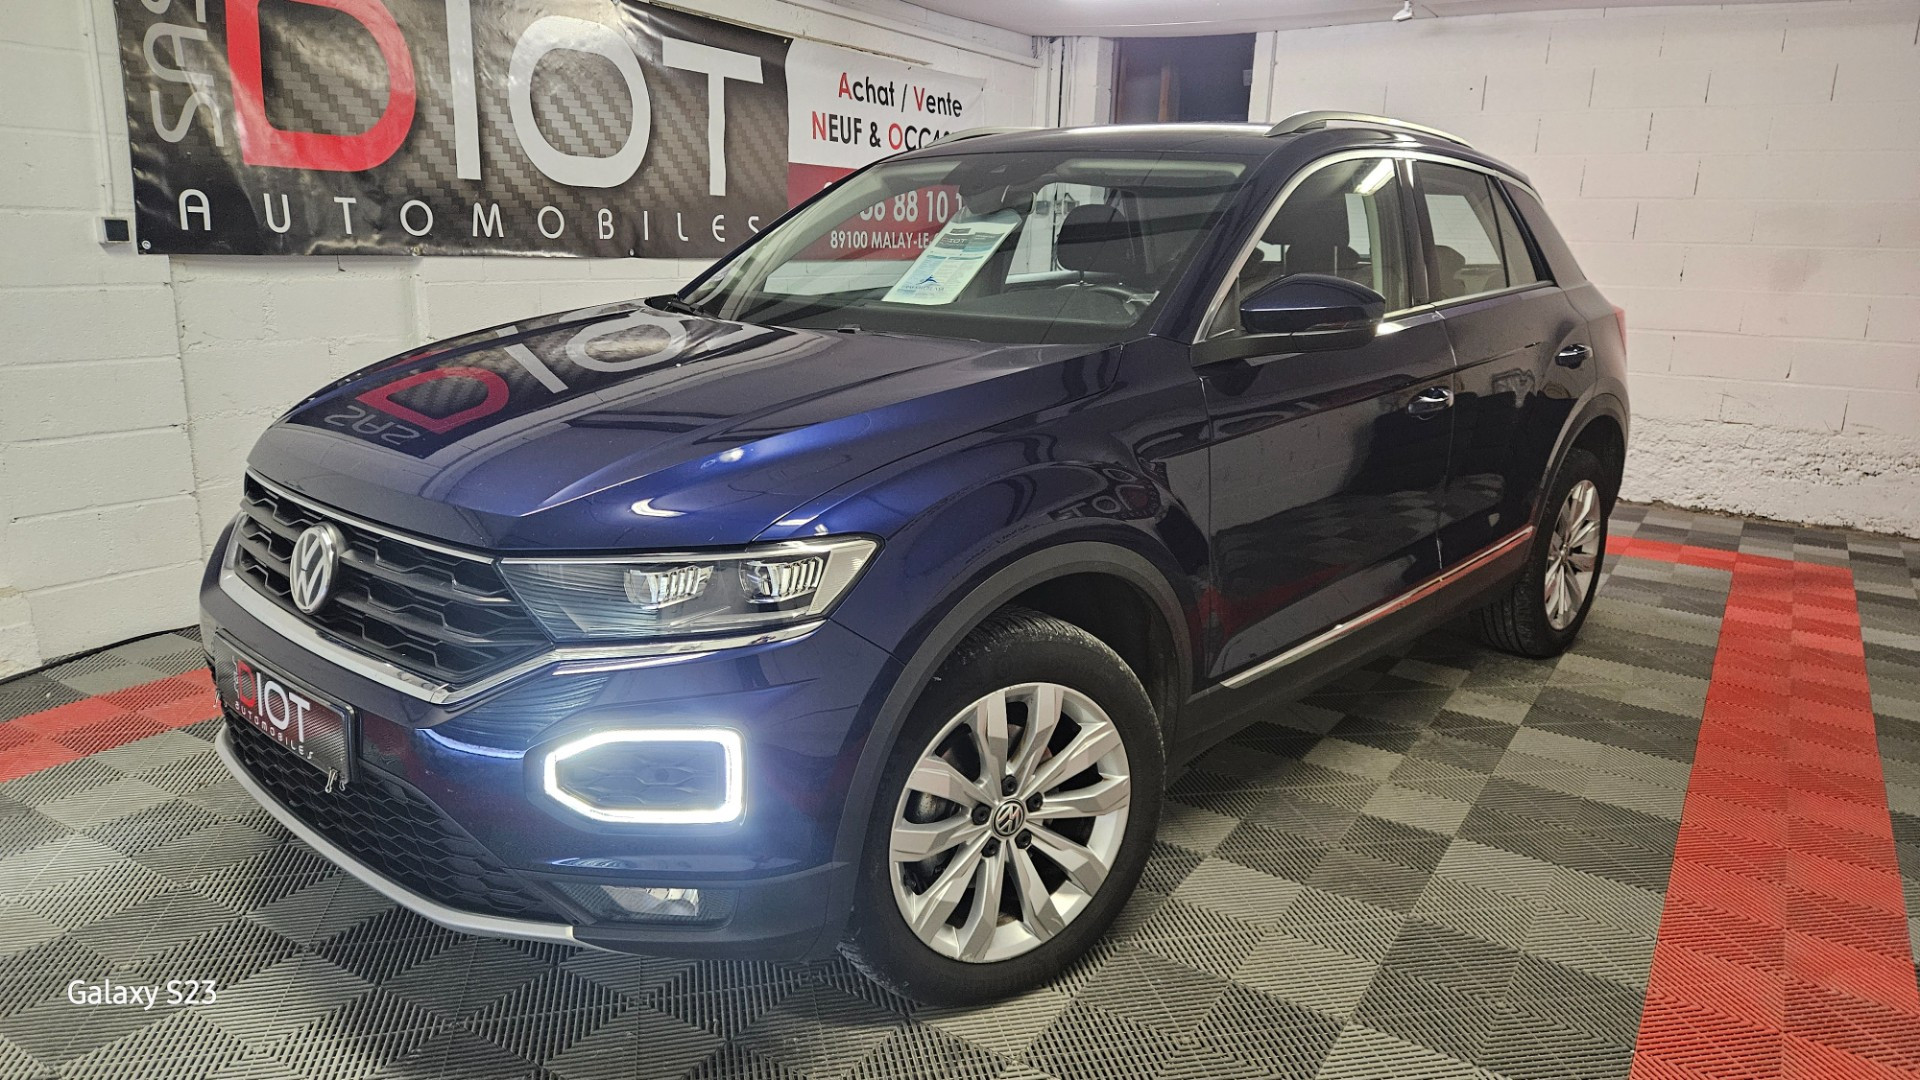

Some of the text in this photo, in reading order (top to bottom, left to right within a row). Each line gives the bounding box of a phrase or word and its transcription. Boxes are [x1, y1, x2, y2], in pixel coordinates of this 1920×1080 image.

[225, 0, 764, 197] DIOT
[838, 72, 895, 107] Achat
[913, 85, 963, 118] Vente
[812, 111, 951, 151] NEUF & OCC
[178, 188, 760, 243] AUTOMOBILES
[893, 190, 919, 222] 88
[926, 190, 949, 223] 10
[830, 230, 868, 249] 89100
[237, 659, 311, 743] DIOT
[234, 700, 314, 760] AUTOMOBILES
